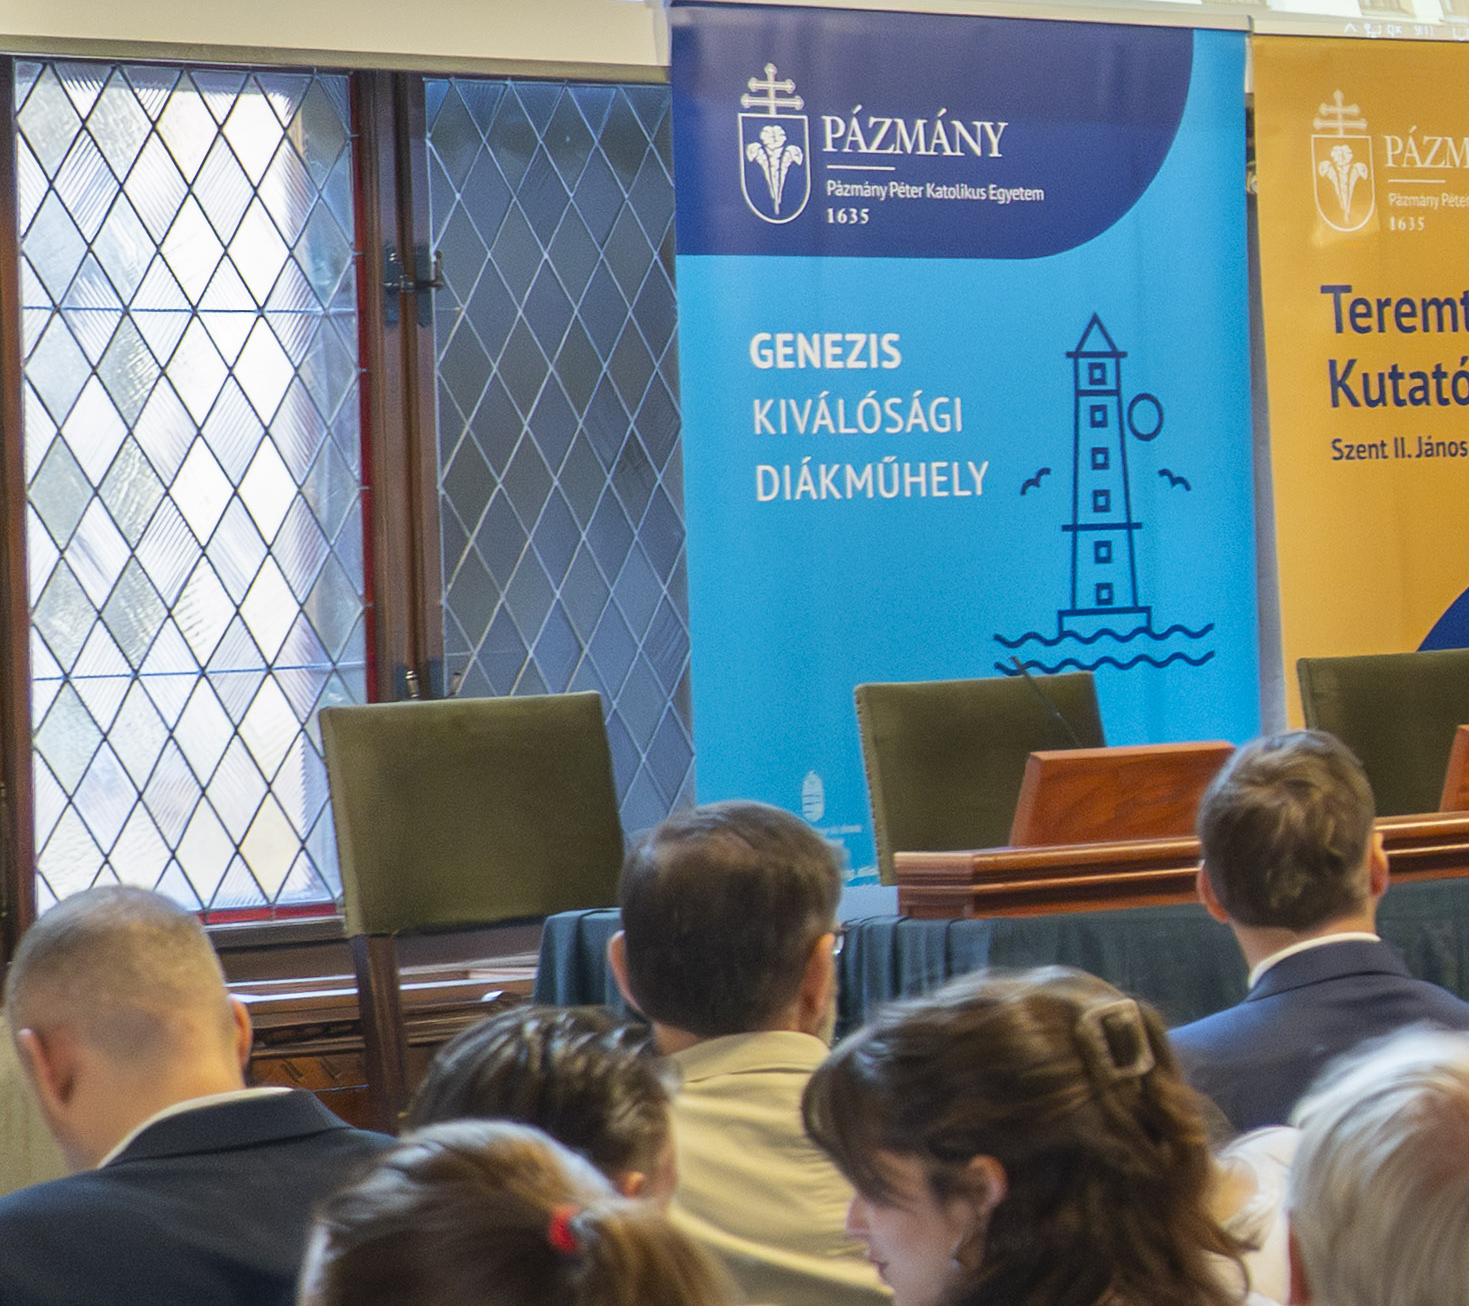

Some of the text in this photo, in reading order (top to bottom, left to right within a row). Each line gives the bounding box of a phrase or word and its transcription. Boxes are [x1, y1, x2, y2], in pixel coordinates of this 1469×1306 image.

[821, 104, 1009, 158] PÁZMÁNY
[826, 180, 1045, 205] Pázmány Péter Katolikus Egyetem
[1388, 192, 1439, 210] Pázmány
[1441, 192, 1469, 208] Péter
[827, 208, 870, 224] 1635
[1389, 216, 1425, 231] 1635
[750, 331, 902, 371] GENEZIS
[753, 389, 962, 436] KIVÁLÓSÁGI
[1331, 437, 1388, 462] Szent
[1394, 436, 1412, 459] II.
[1414, 434, 1468, 459] János
[755, 453, 990, 503] DIÁKMŰHELY
